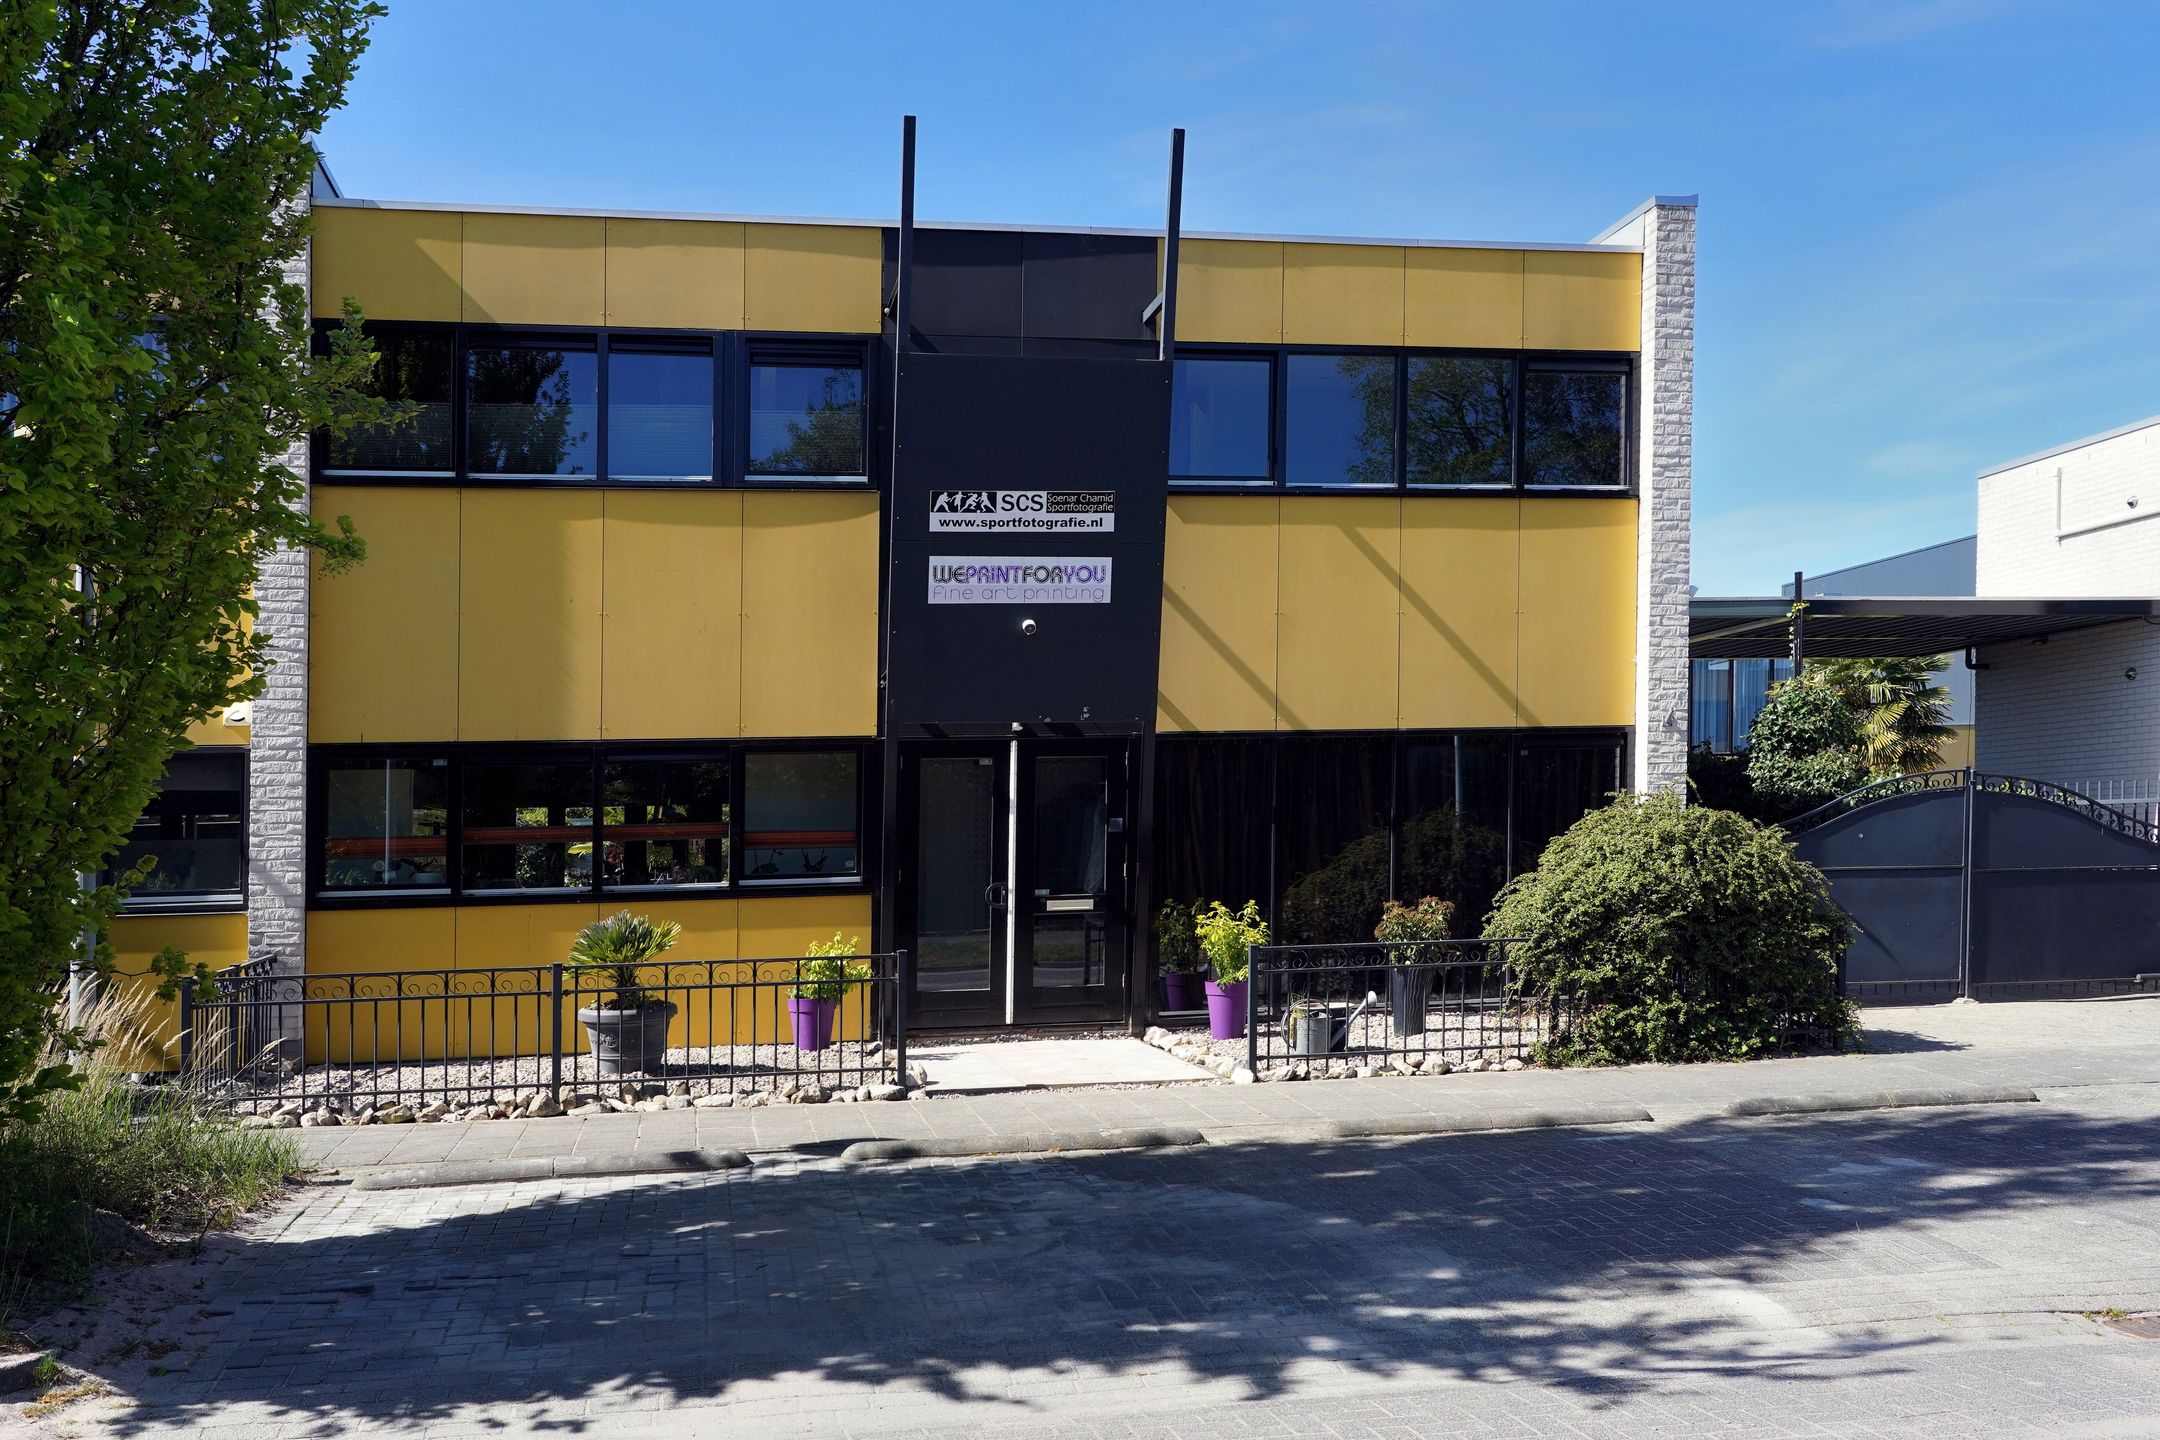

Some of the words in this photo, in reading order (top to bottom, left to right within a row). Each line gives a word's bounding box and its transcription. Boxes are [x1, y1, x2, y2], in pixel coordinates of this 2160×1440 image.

[1001, 494, 1044, 512] SCS
[1047, 494, 1078, 503] Soenar
[1080, 494, 1113, 502] Chamid
[1047, 503, 1114, 512] Sportfotografie
[939, 517, 1103, 530] www.sportfotografie.nl
[933, 585, 973, 600] fine
[982, 585, 1017, 600] art
[1023, 586, 1104, 602] printing
